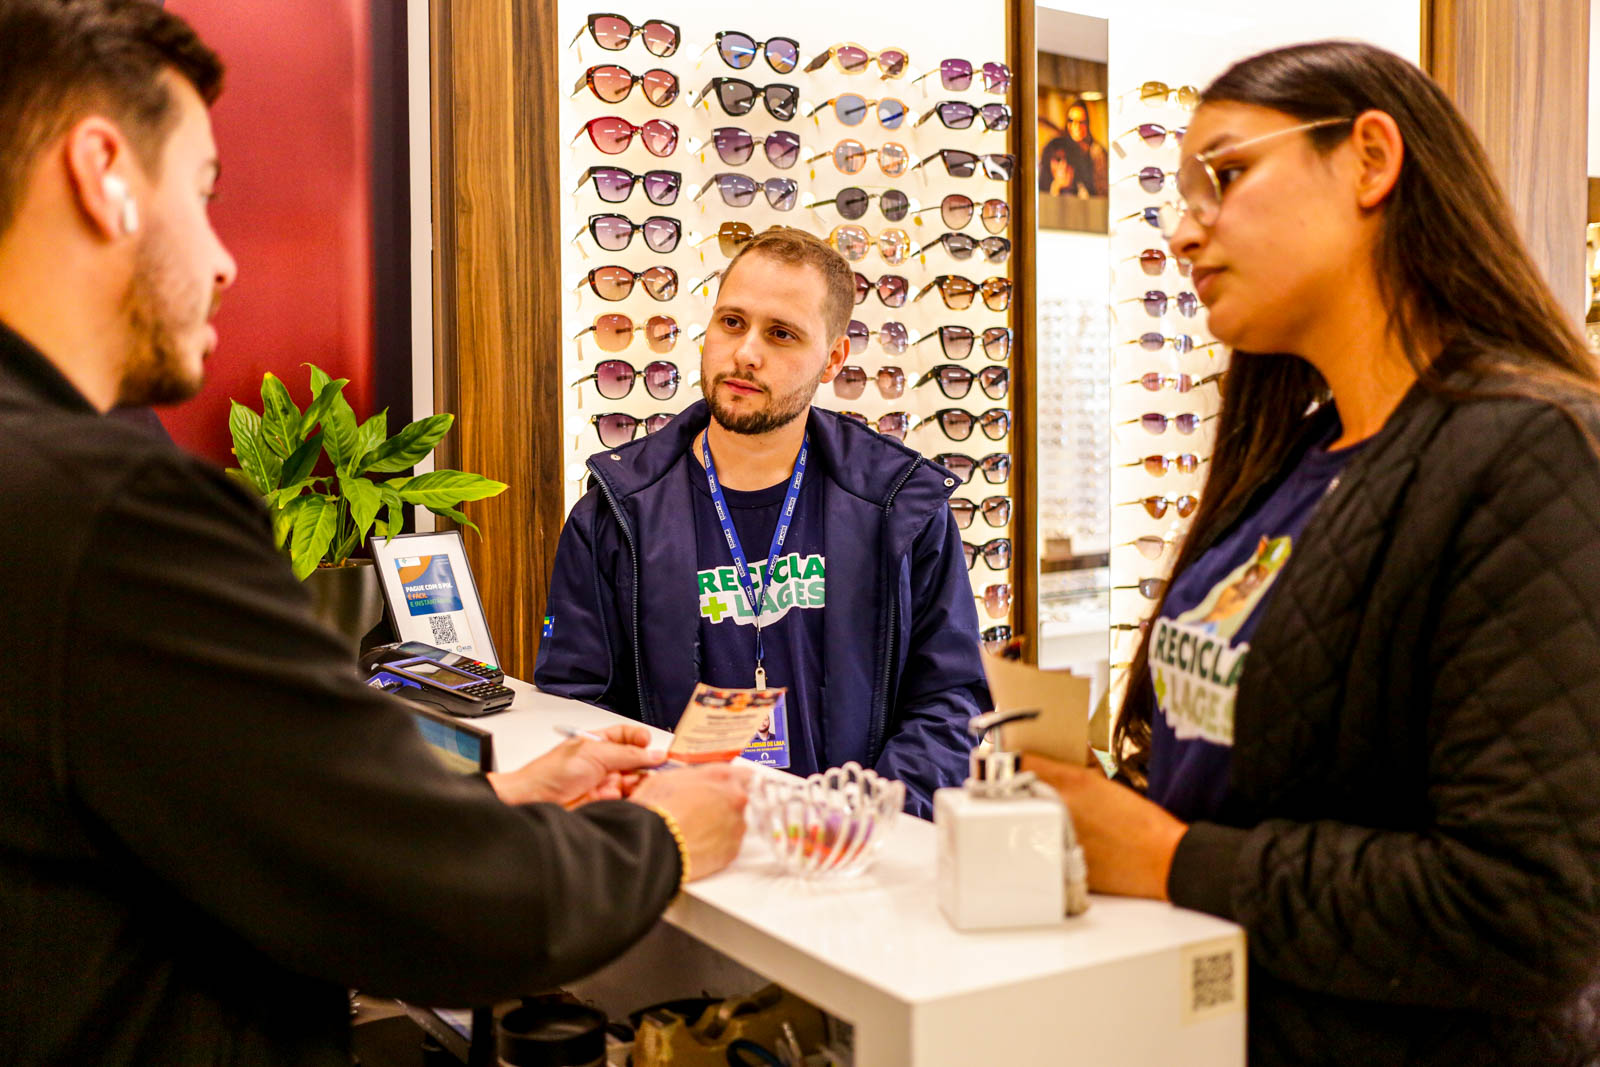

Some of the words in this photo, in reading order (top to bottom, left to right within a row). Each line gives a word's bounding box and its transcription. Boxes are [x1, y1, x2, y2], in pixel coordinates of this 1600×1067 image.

[405, 584, 424, 592] PAGUE
[424, 583, 438, 591] COM
[697, 555, 825, 595] RECICLA
[734, 581, 825, 617] LAGES
